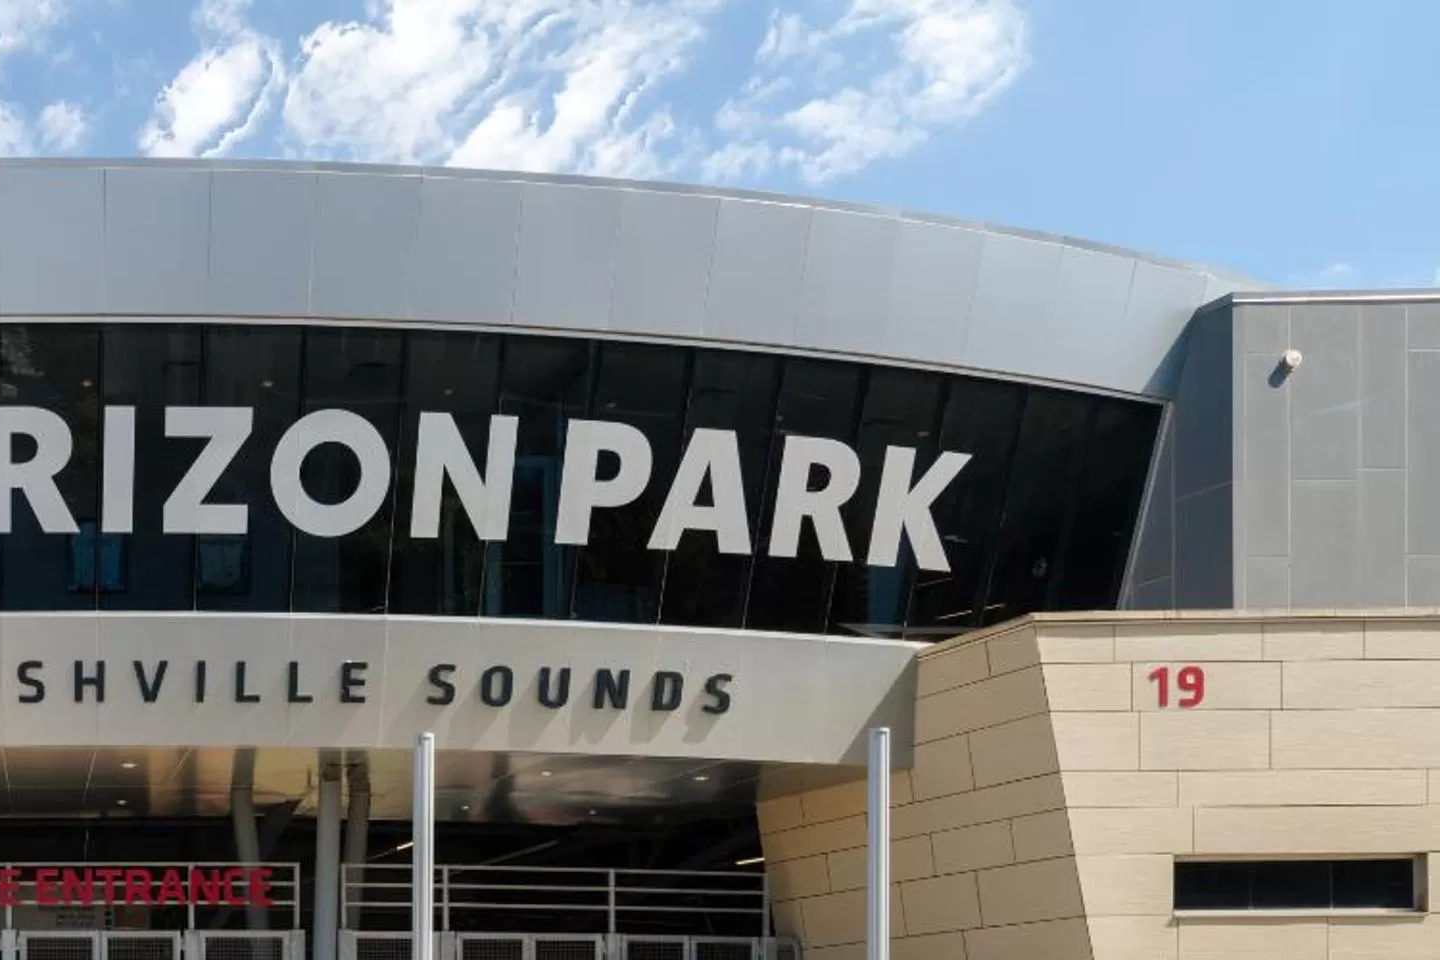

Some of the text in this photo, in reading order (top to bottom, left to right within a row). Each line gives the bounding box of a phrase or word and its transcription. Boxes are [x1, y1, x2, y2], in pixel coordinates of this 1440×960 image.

[553, 418, 972, 572] PARK
[425, 662, 734, 715] SOUNDS
[1147, 664, 1206, 709] 19
[33, 867, 273, 908] ENTRANCE
